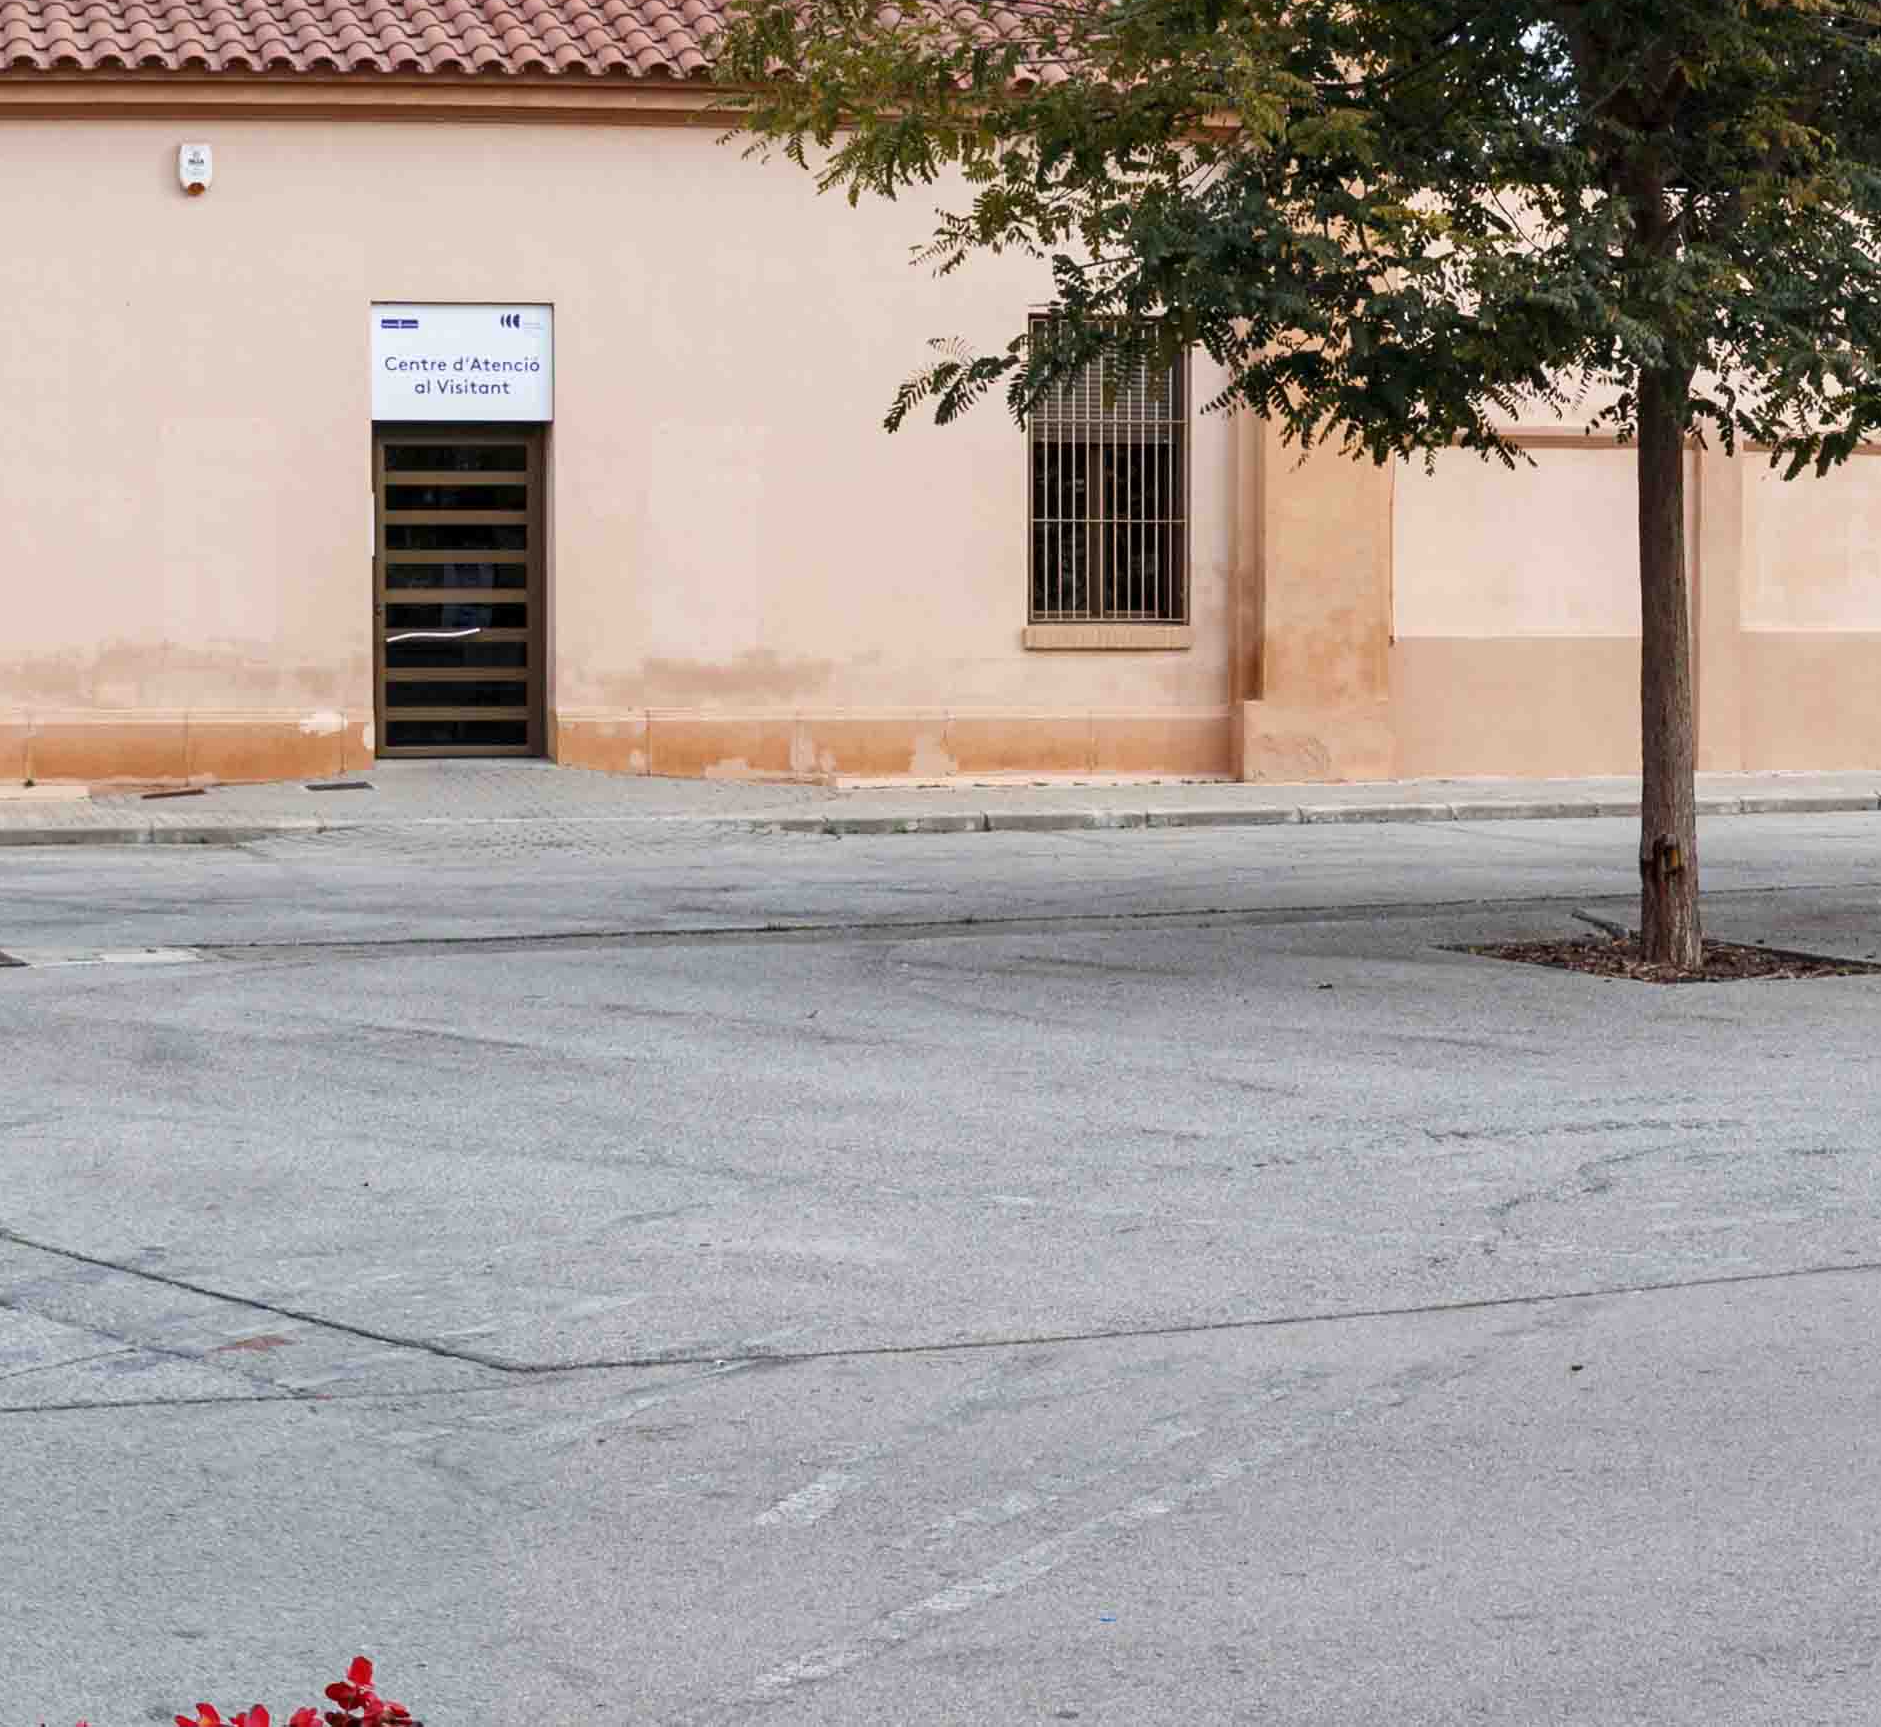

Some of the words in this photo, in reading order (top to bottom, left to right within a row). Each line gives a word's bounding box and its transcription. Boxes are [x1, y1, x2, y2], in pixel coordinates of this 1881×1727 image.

[385, 356, 447, 371] Centre
[453, 355, 540, 372] d'Atenció
[415, 378, 430, 394] al
[437, 378, 510, 394] Visitant
